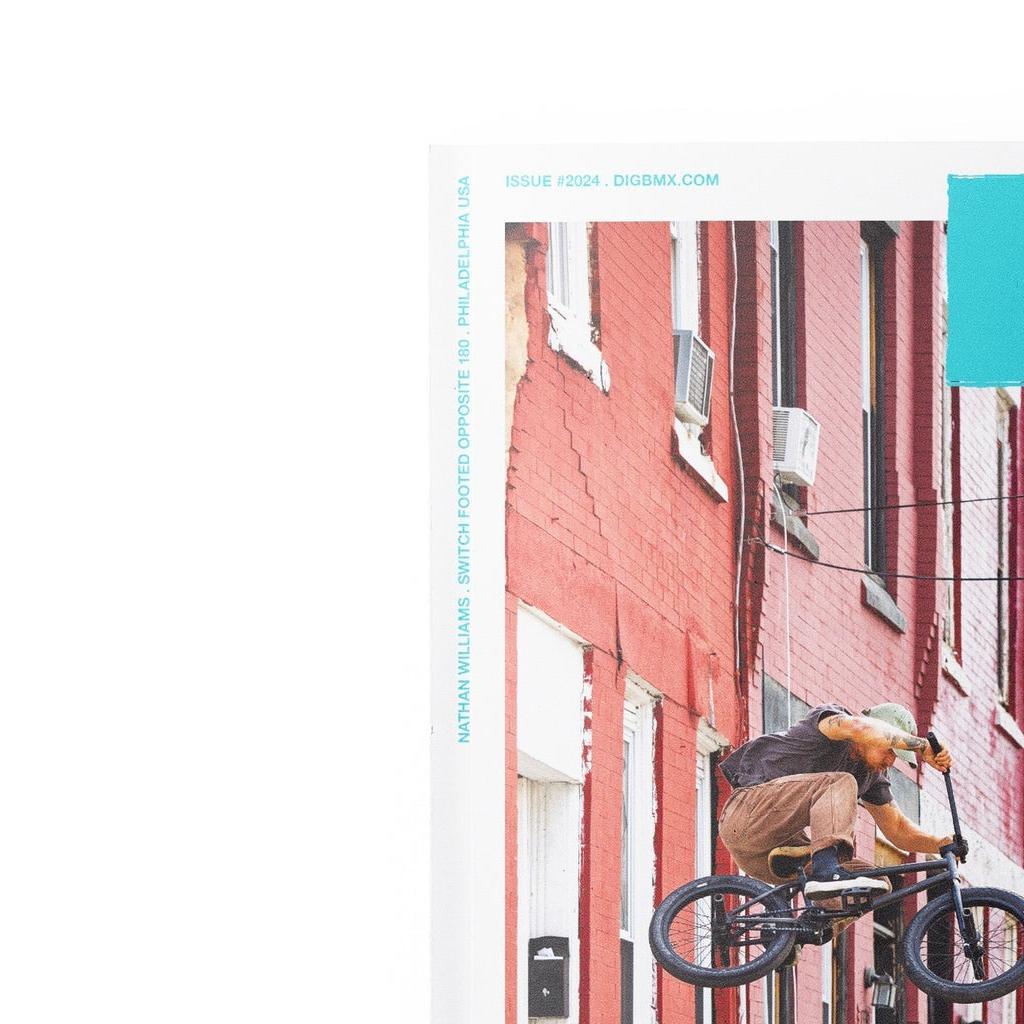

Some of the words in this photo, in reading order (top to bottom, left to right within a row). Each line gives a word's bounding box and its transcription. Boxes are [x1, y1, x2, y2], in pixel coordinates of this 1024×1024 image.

[458, 176, 469, 208] USA
[505, 175, 551, 188] ISSUE
[557, 175, 601, 188] #2024
[613, 174, 720, 187] DIGBMX.COM
[458, 213, 469, 327] PHILADELPHIA
[458, 339, 470, 364] 180
[457, 371, 470, 449] OPPOSITE
[457, 454, 470, 519] FOOTED
[457, 522, 470, 585] SWITCH
[457, 597, 470, 676] WILLIAMS
[457, 680, 470, 744] NATHAN
